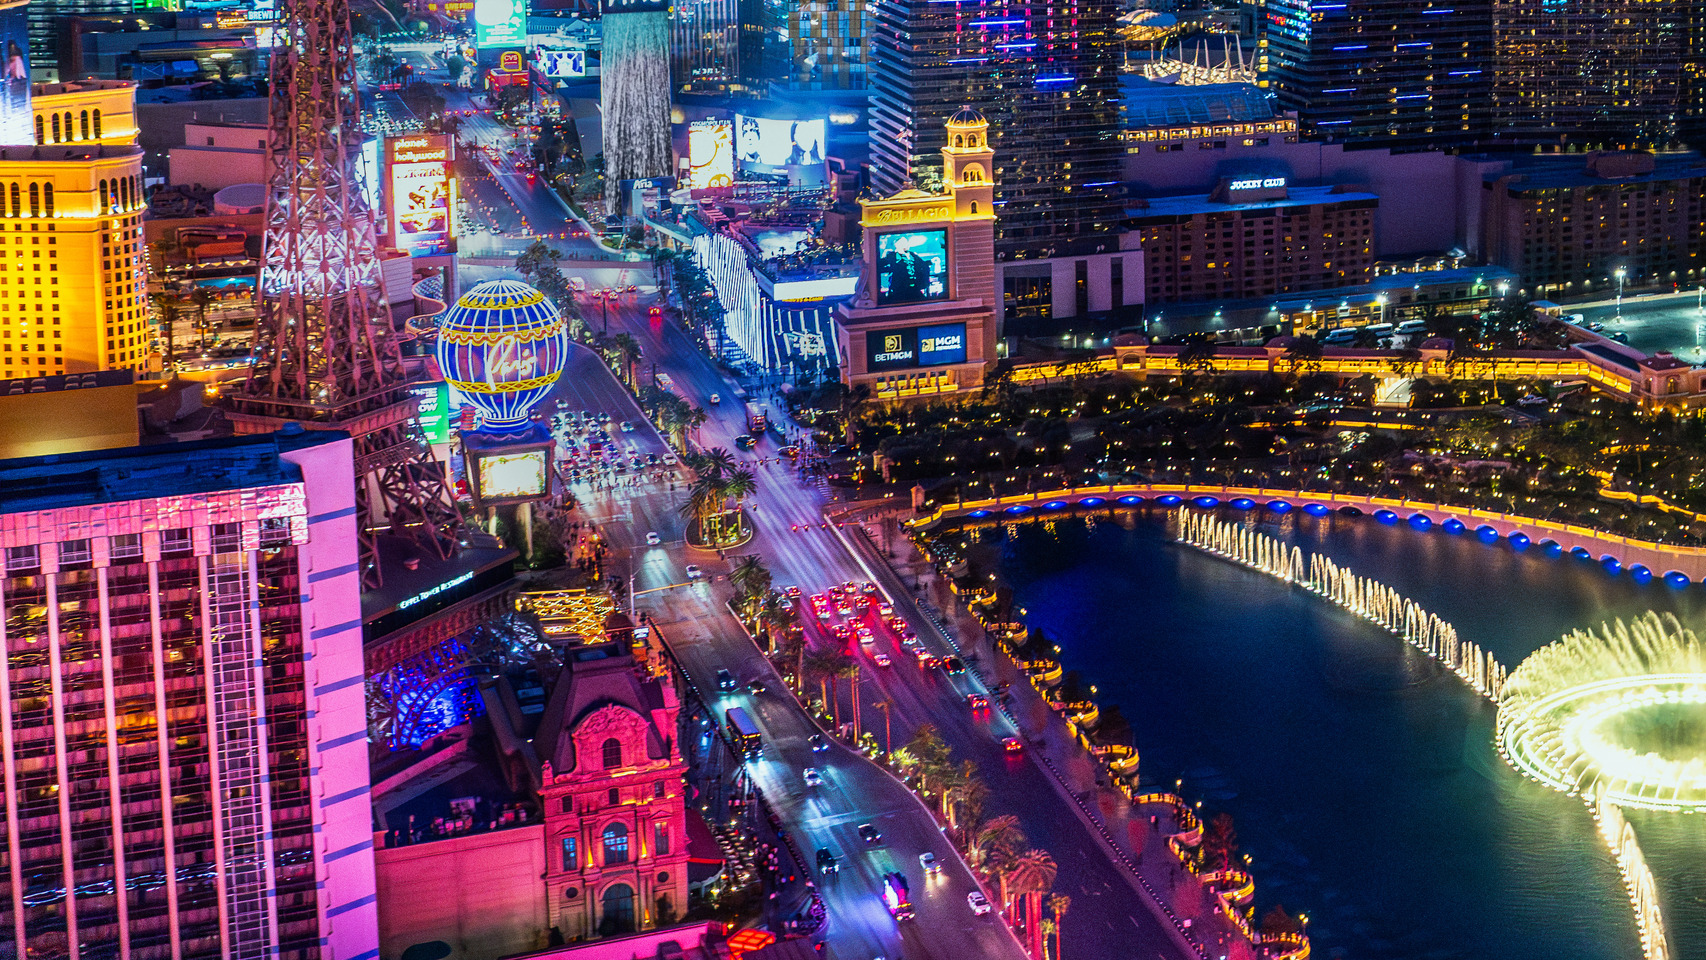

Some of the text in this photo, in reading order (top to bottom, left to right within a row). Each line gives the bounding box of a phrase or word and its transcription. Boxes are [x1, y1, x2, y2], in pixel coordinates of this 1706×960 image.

[394, 138, 429, 151] planet
[394, 150, 446, 162] hollywood
[633, 178, 653, 190] Aria
[1230, 178, 1285, 190] JOCKEY CLUB
[877, 207, 949, 223] BELLAGIO
[935, 335, 961, 346] MGM
[874, 350, 913, 363] BETMGM
[485, 335, 538, 392] Paris
[419, 586, 440, 601] TOWER
